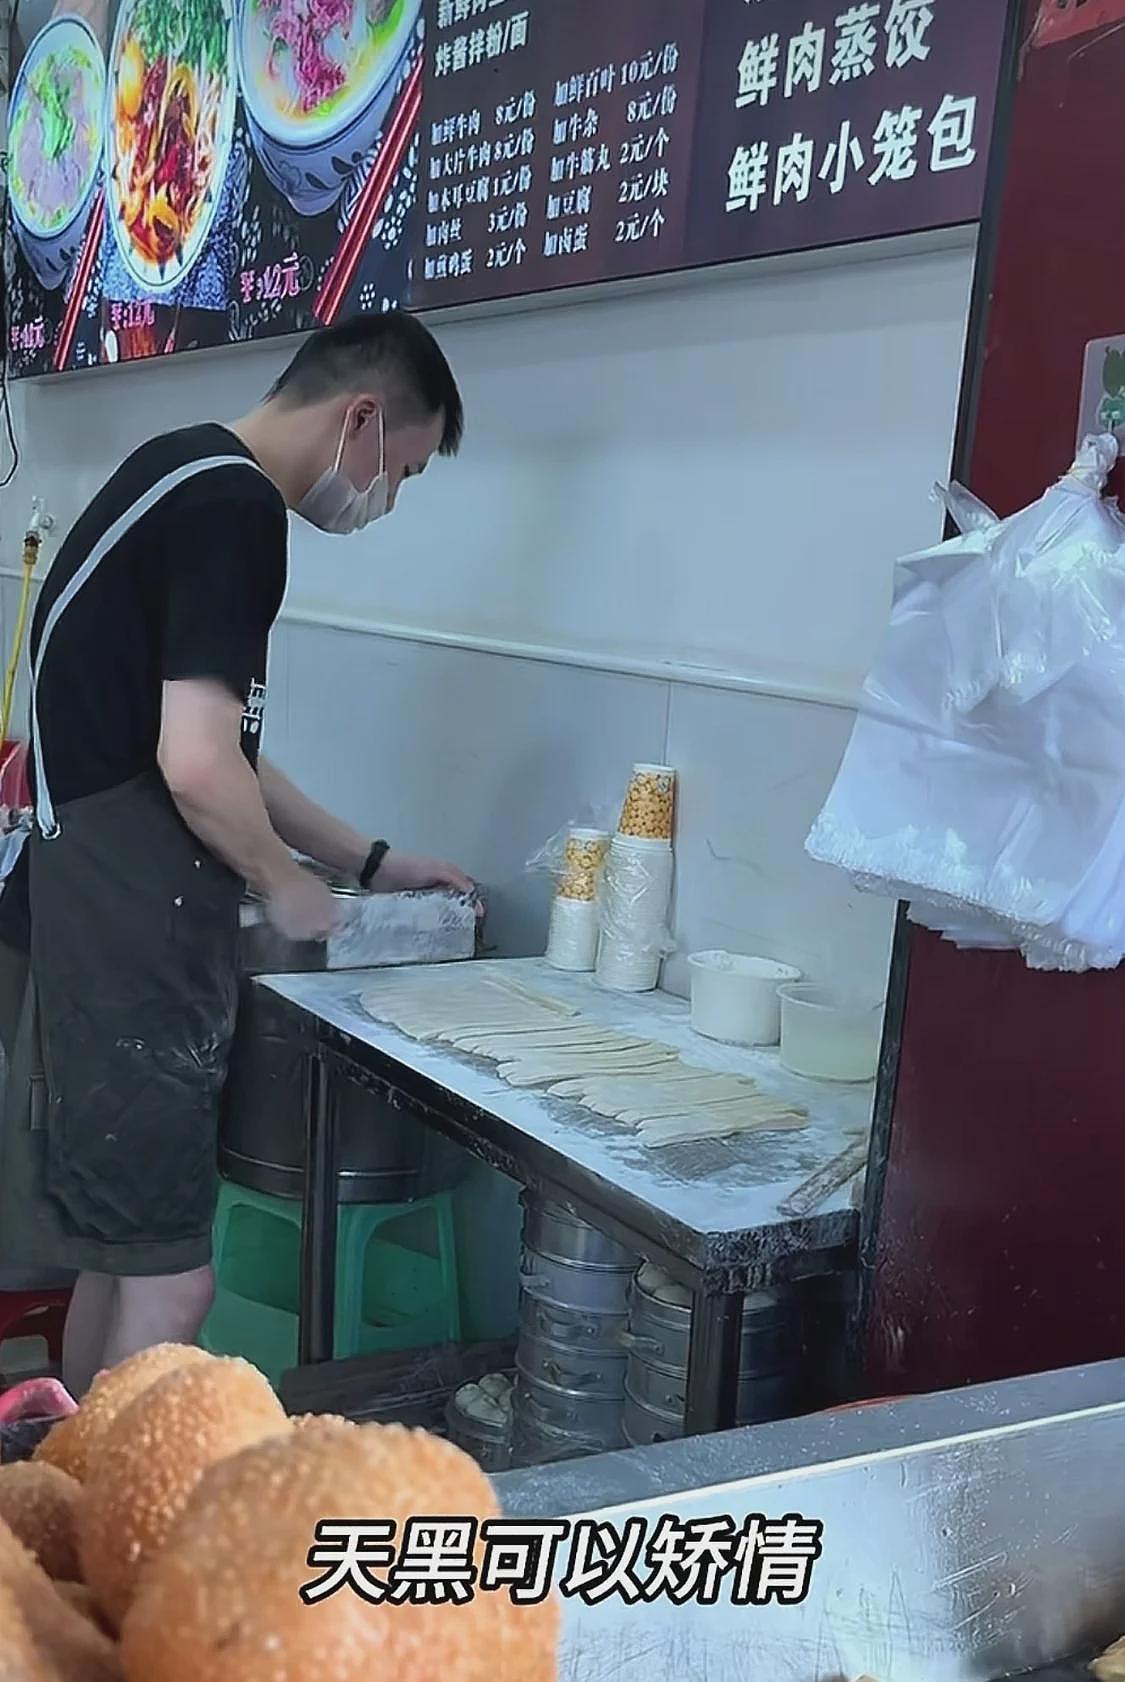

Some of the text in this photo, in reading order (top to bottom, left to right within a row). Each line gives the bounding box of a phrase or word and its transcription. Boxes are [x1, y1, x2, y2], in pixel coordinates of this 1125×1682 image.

[438, 0, 505, 29] 新鲜
[434, 11, 529, 77] 炸酱拌粉/面
[735, 0, 935, 108] 鲜肉蒸饺
[621, 42, 678, 85] 10元/份
[495, 90, 535, 125] 8元/份
[627, 84, 677, 122] 8元/份
[494, 128, 534, 160] 8元/份
[620, 127, 670, 164] 2元/个
[726, 94, 977, 213] 鲜肉小笼包
[493, 164, 532, 197] 1元/份
[618, 167, 669, 202] 2元/块
[487, 202, 528, 232] 3元/份
[615, 207, 665, 242] 2元/个
[486, 238, 527, 268] 2元/个
